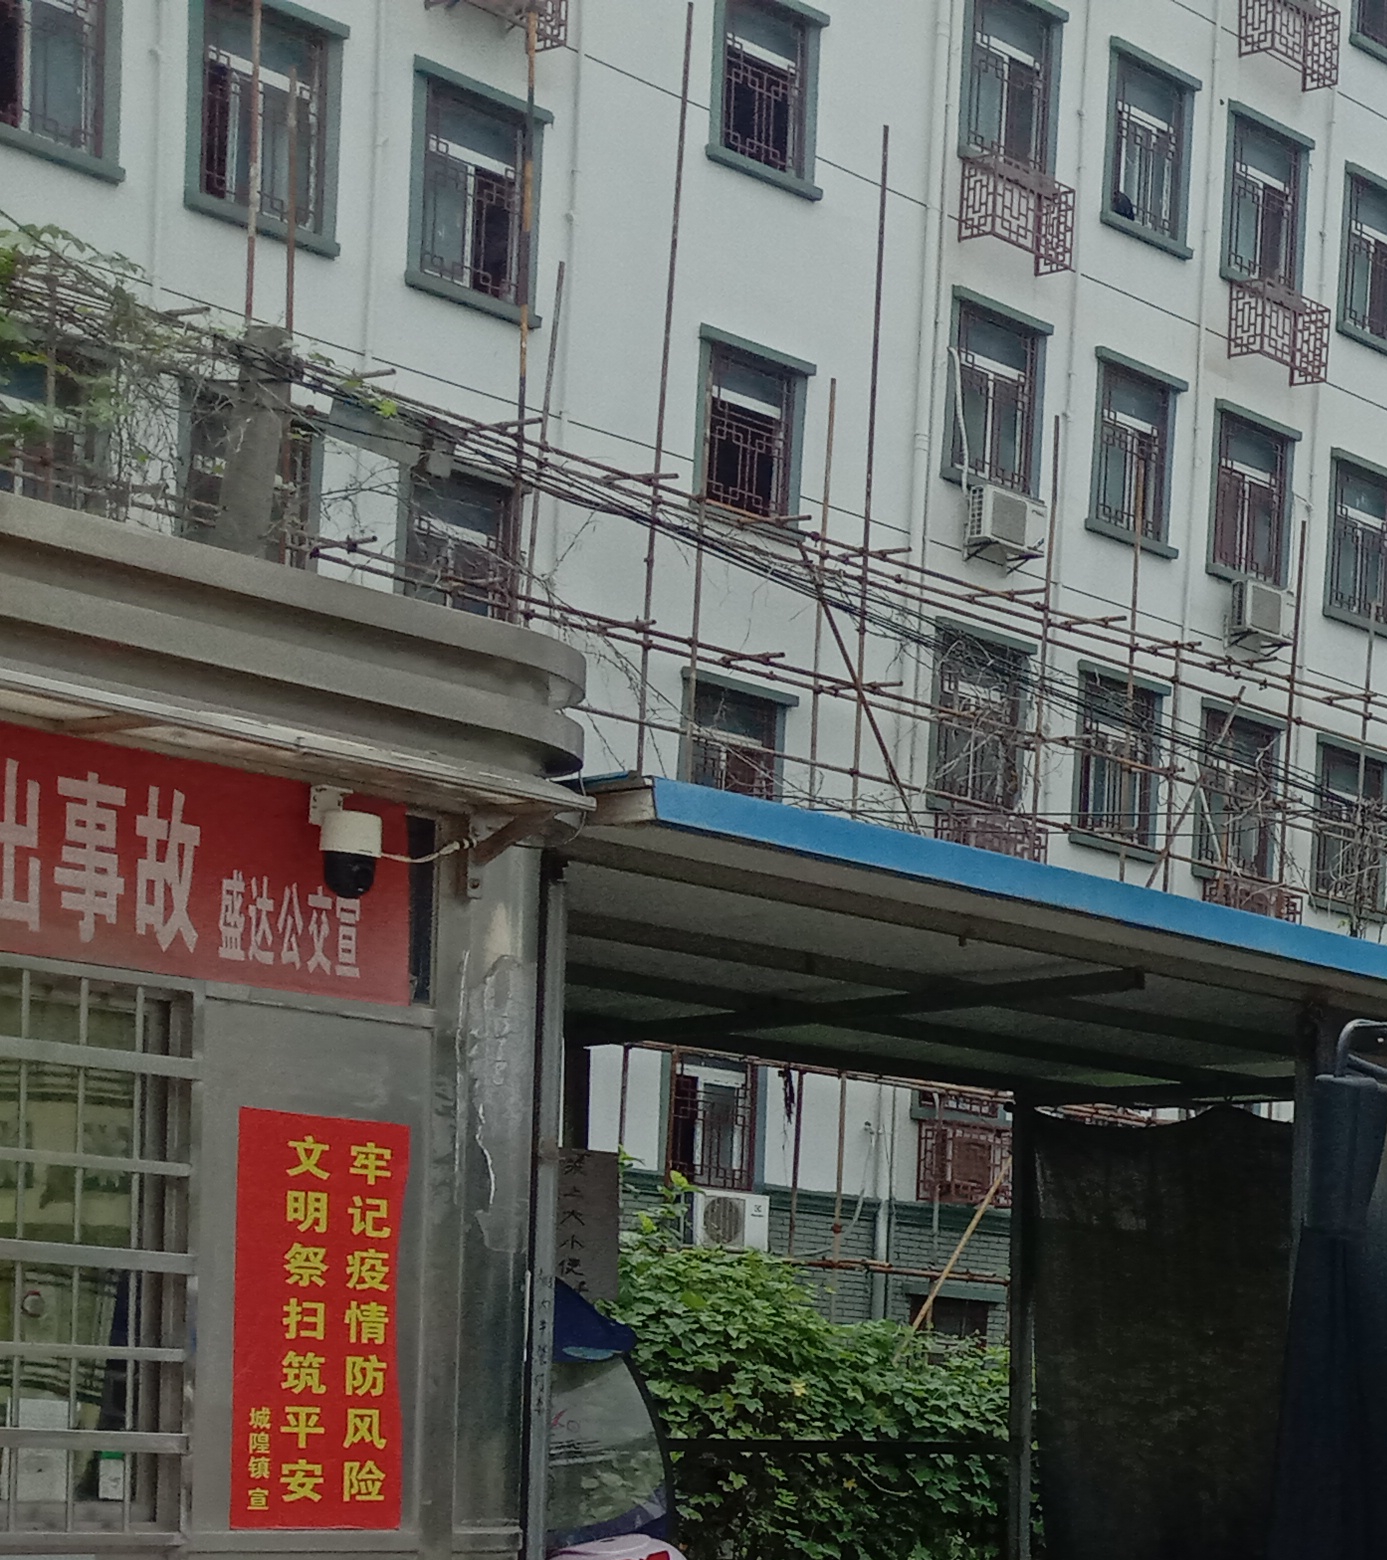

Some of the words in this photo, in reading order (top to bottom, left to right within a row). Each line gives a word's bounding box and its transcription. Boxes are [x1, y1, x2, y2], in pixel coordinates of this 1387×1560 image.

[0, 757, 200, 953] 出事故
[279, 1136, 331, 1503] 文明祭扫筑平安
[342, 1143, 392, 1502] 牢记疫情防风险
[247, 1407, 272, 1479] 城隍镇
[247, 1487, 270, 1511] 宣
